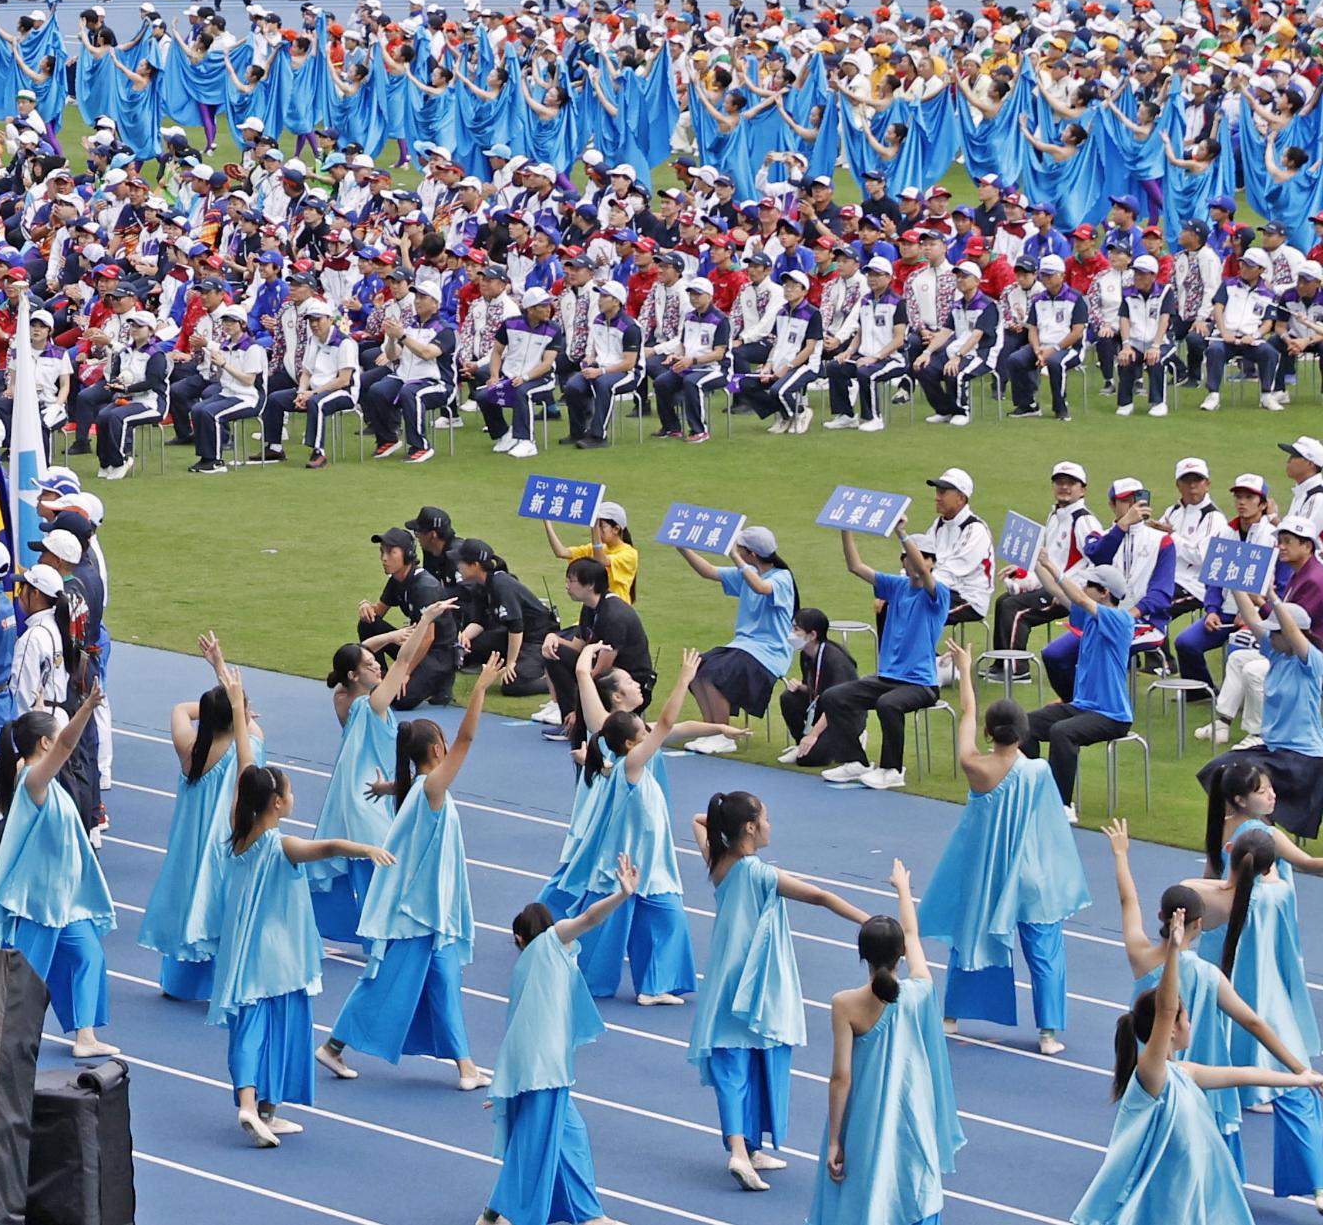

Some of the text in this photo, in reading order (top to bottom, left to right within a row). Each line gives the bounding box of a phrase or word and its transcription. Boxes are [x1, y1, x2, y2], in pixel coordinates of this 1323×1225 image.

[527, 491, 586, 521] 新潟県
[828, 502, 886, 529] 山梨県
[666, 521, 724, 548] 石川県
[1207, 556, 1257, 587] 愛知県
